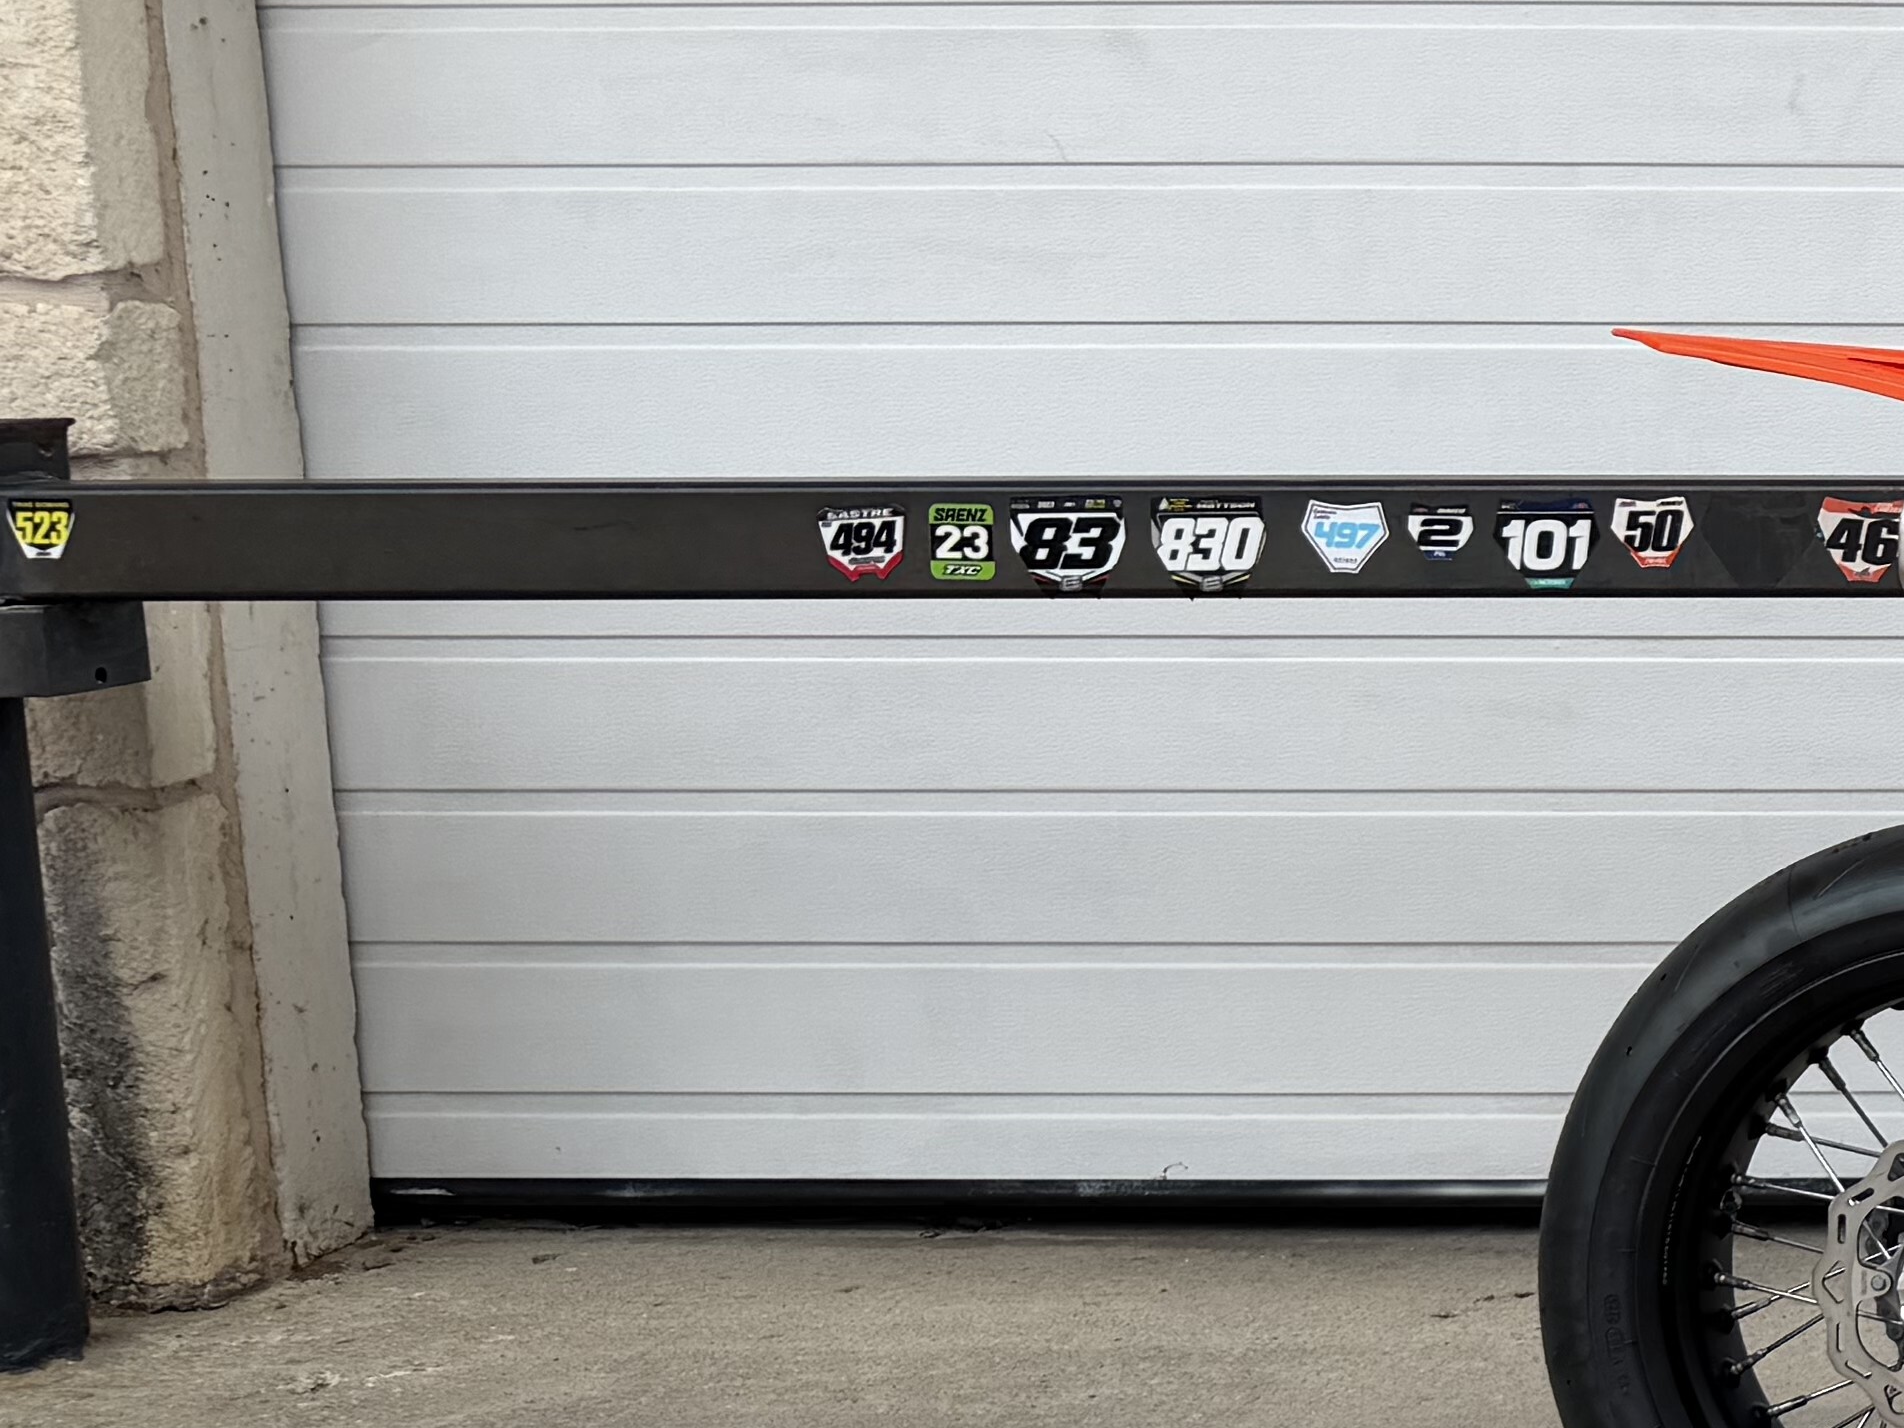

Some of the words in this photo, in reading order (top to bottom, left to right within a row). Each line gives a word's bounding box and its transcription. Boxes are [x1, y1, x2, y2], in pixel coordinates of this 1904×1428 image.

[15, 511, 69, 545] 523
[829, 520, 897, 557] 494
[935, 525, 989, 560] 23
[1020, 517, 1121, 570] 83
[1157, 517, 1265, 571] 830
[1314, 521, 1380, 549] 497
[1502, 519, 1592, 571] 101
[1623, 509, 1684, 553] 50
[1826, 518, 1900, 565] 46
